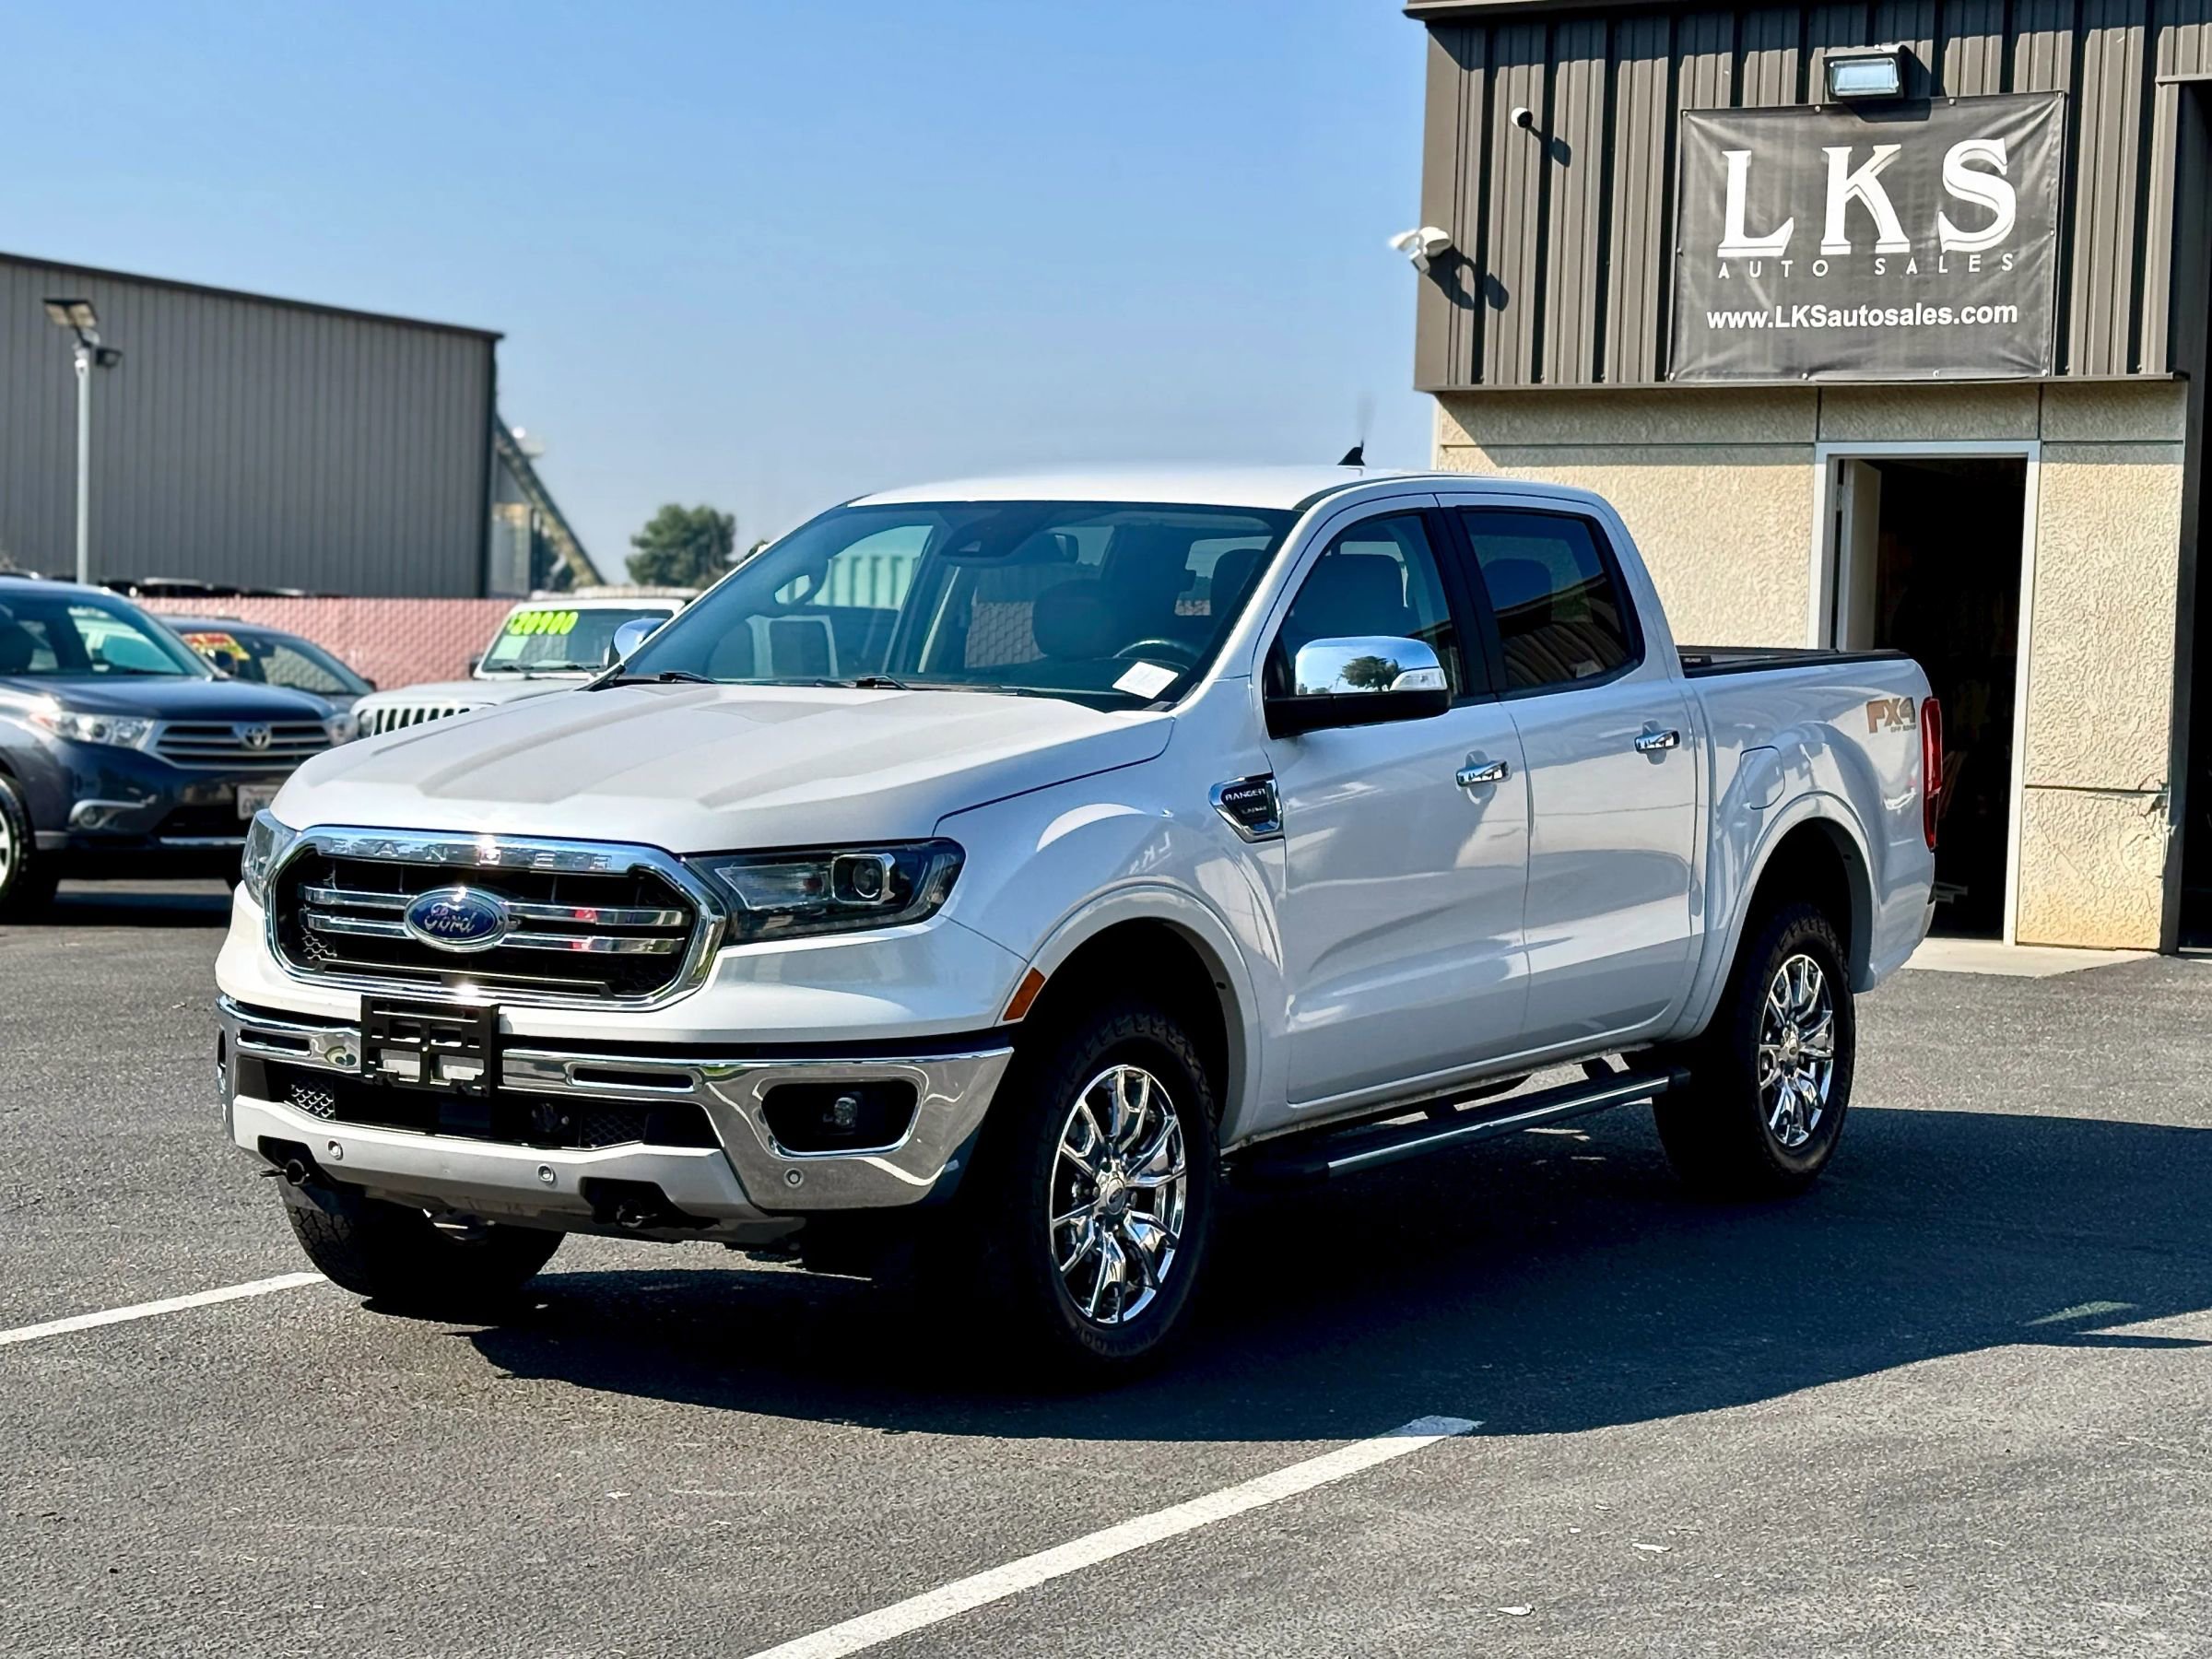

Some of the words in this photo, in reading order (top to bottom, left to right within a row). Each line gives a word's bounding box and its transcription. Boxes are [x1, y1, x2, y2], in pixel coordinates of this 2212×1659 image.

[1717, 137, 2017, 257] LKS
[1718, 259, 1829, 278] AUTO
[1875, 253, 2014, 276] SALES
[1706, 302, 2018, 329] www.LKSautosales.com
[1866, 697, 1916, 734] FX4
[1225, 788, 1266, 801] RANGER
[425, 902, 477, 933] Ford
